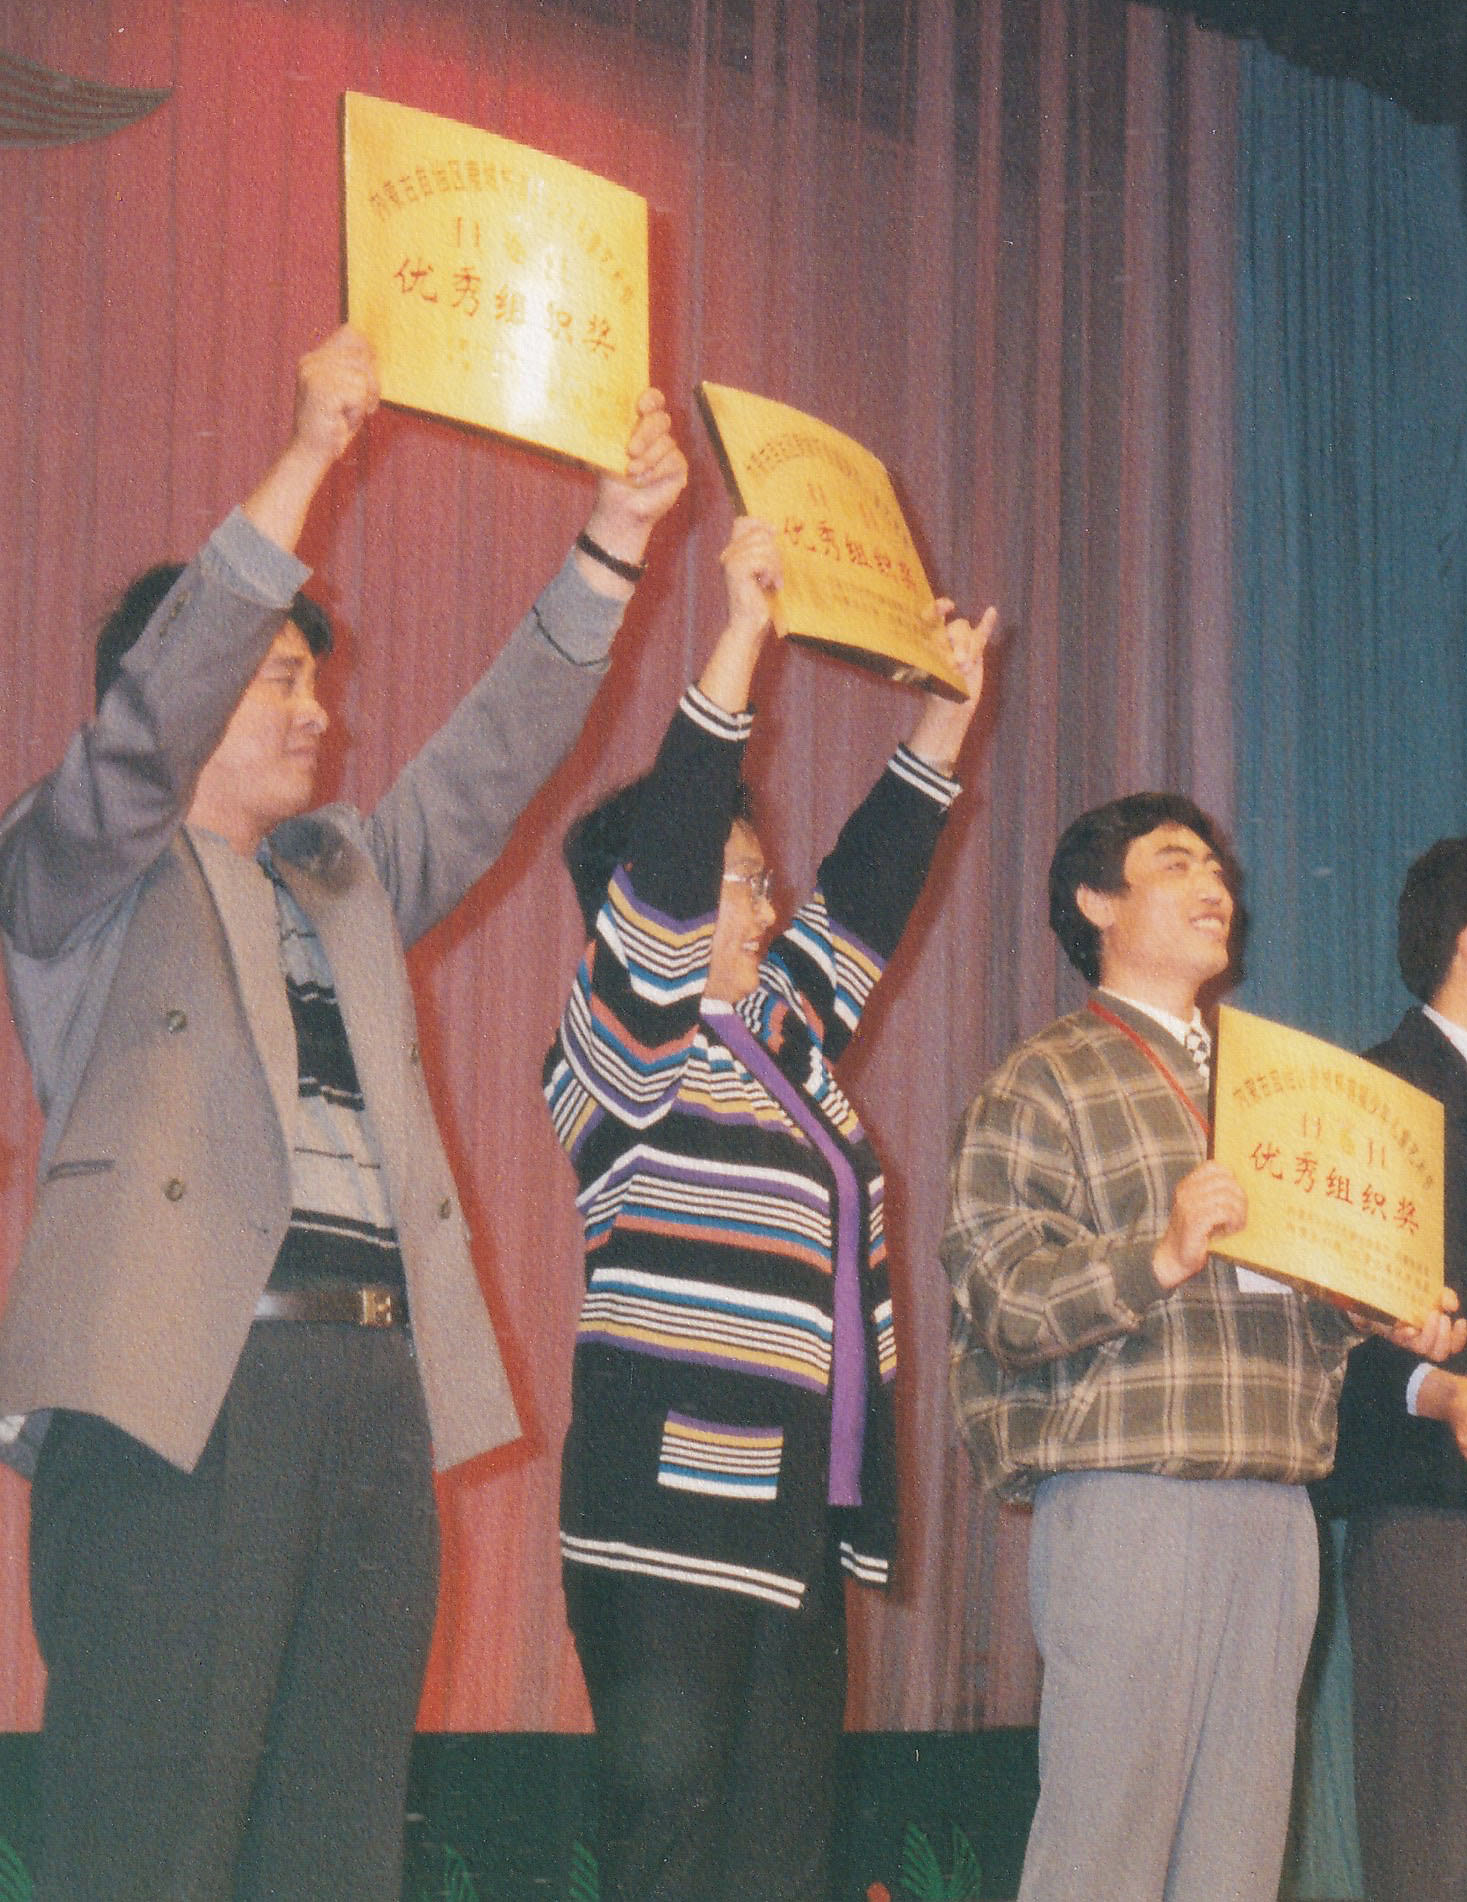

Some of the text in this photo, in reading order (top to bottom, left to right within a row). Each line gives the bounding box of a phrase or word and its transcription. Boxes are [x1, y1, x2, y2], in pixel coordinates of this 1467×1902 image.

[393, 257, 615, 359] 优秀组织奖
[1250, 1142, 1419, 1234] 优秀组织奖
